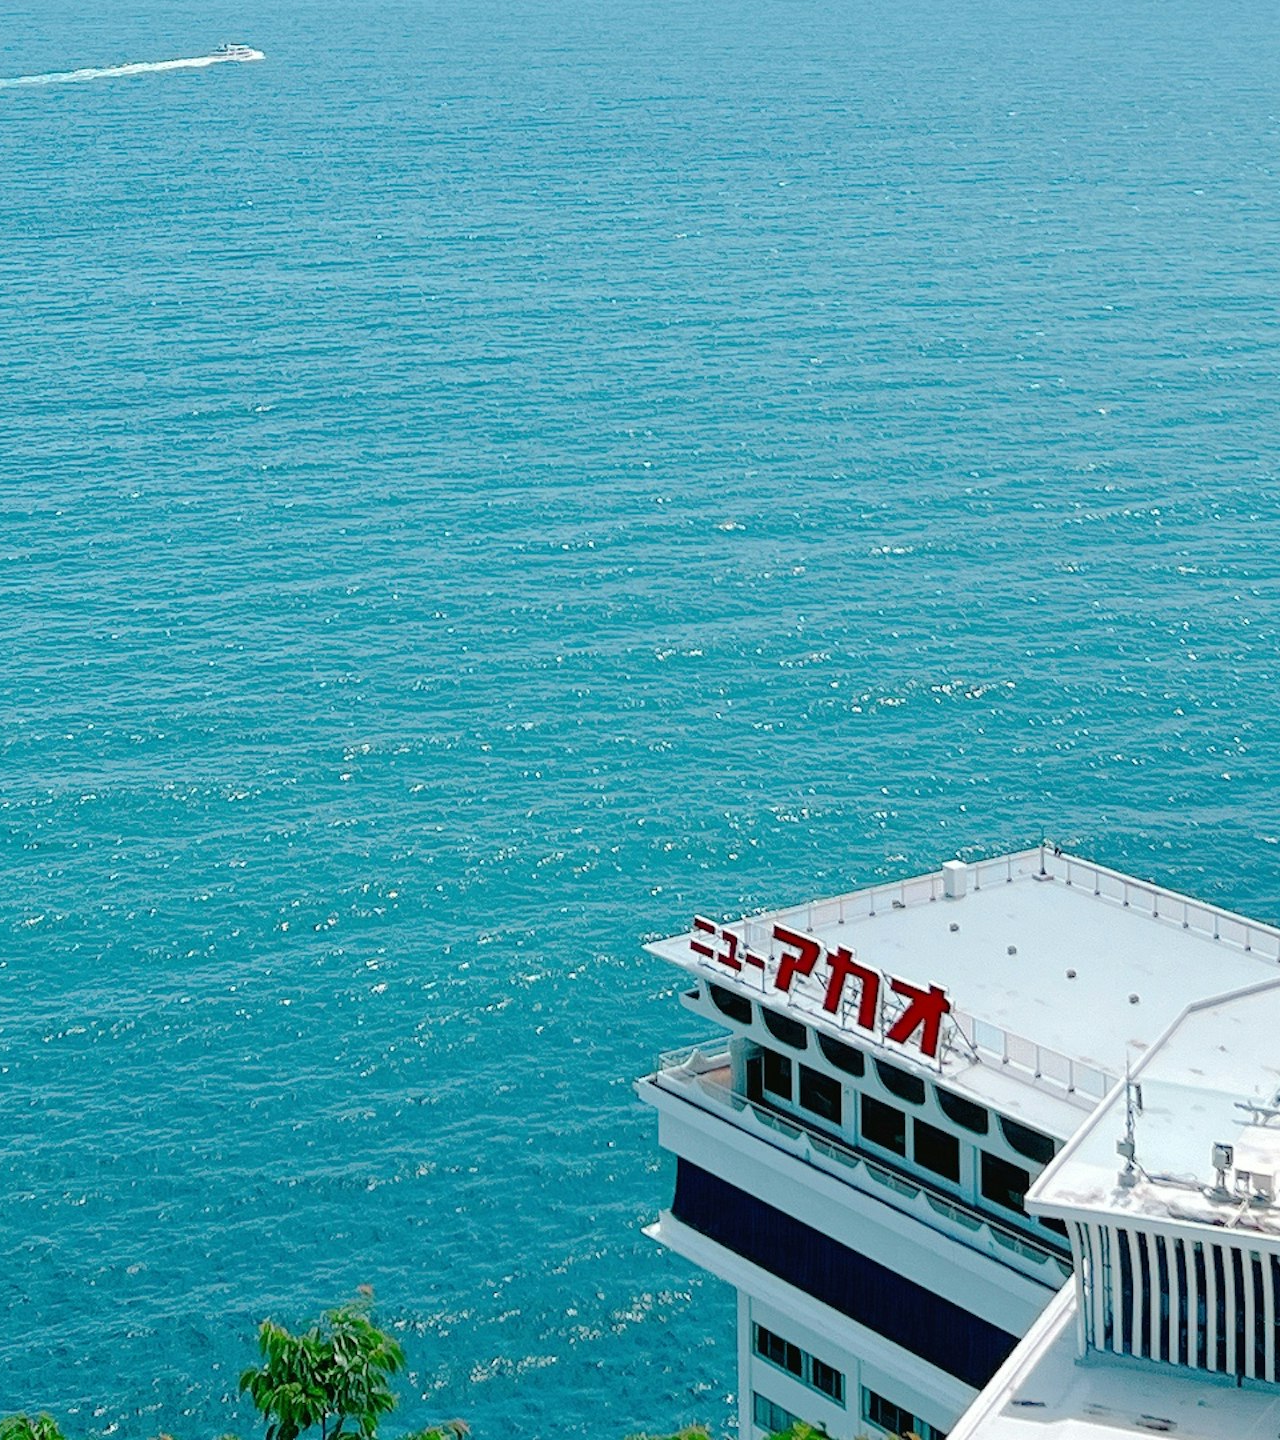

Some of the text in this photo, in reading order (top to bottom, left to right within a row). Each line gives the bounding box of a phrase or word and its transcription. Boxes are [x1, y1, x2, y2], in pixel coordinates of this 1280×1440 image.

[690, 914, 951, 1058] ニューアカオ
